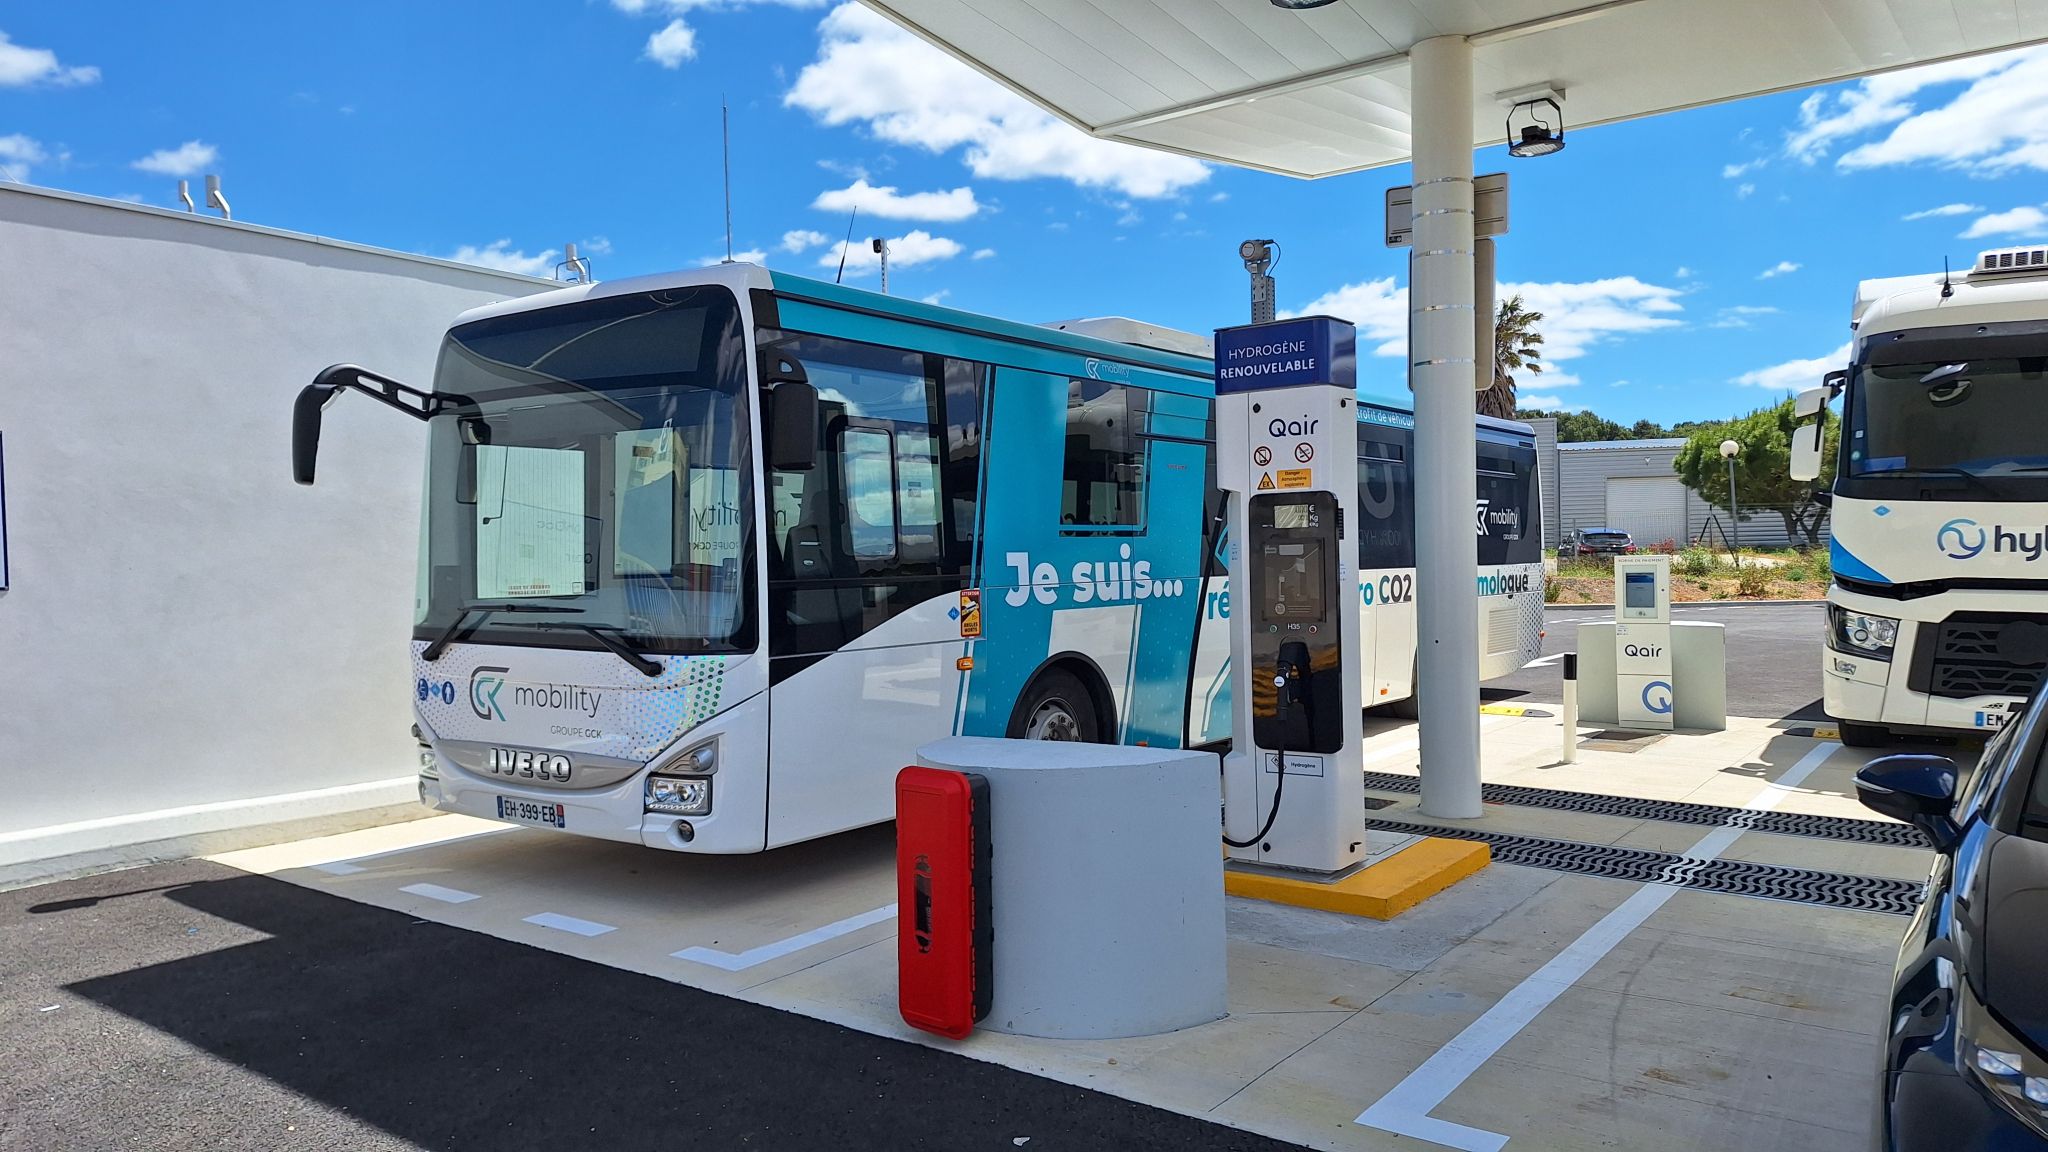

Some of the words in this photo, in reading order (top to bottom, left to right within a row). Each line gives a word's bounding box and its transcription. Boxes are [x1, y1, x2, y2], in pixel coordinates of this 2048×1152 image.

[1228, 340, 1306, 361] HYDROGÈNE
[1220, 358, 1315, 380] RENOUVELABLE
[1268, 414, 1319, 438] Qair
[1489, 507, 1518, 529] mobility
[1004, 551, 1060, 607] Je
[1072, 543, 1184, 603] suis...
[1378, 574, 1412, 604] CO2
[1624, 643, 1662, 658] Qair
[514, 683, 602, 719] mobility
[550, 725, 584, 738] GROUPE
[584, 728, 602, 739] GCK
[488, 748, 572, 782] IVECO
[1290, 761, 1316, 769] Hydrogène
